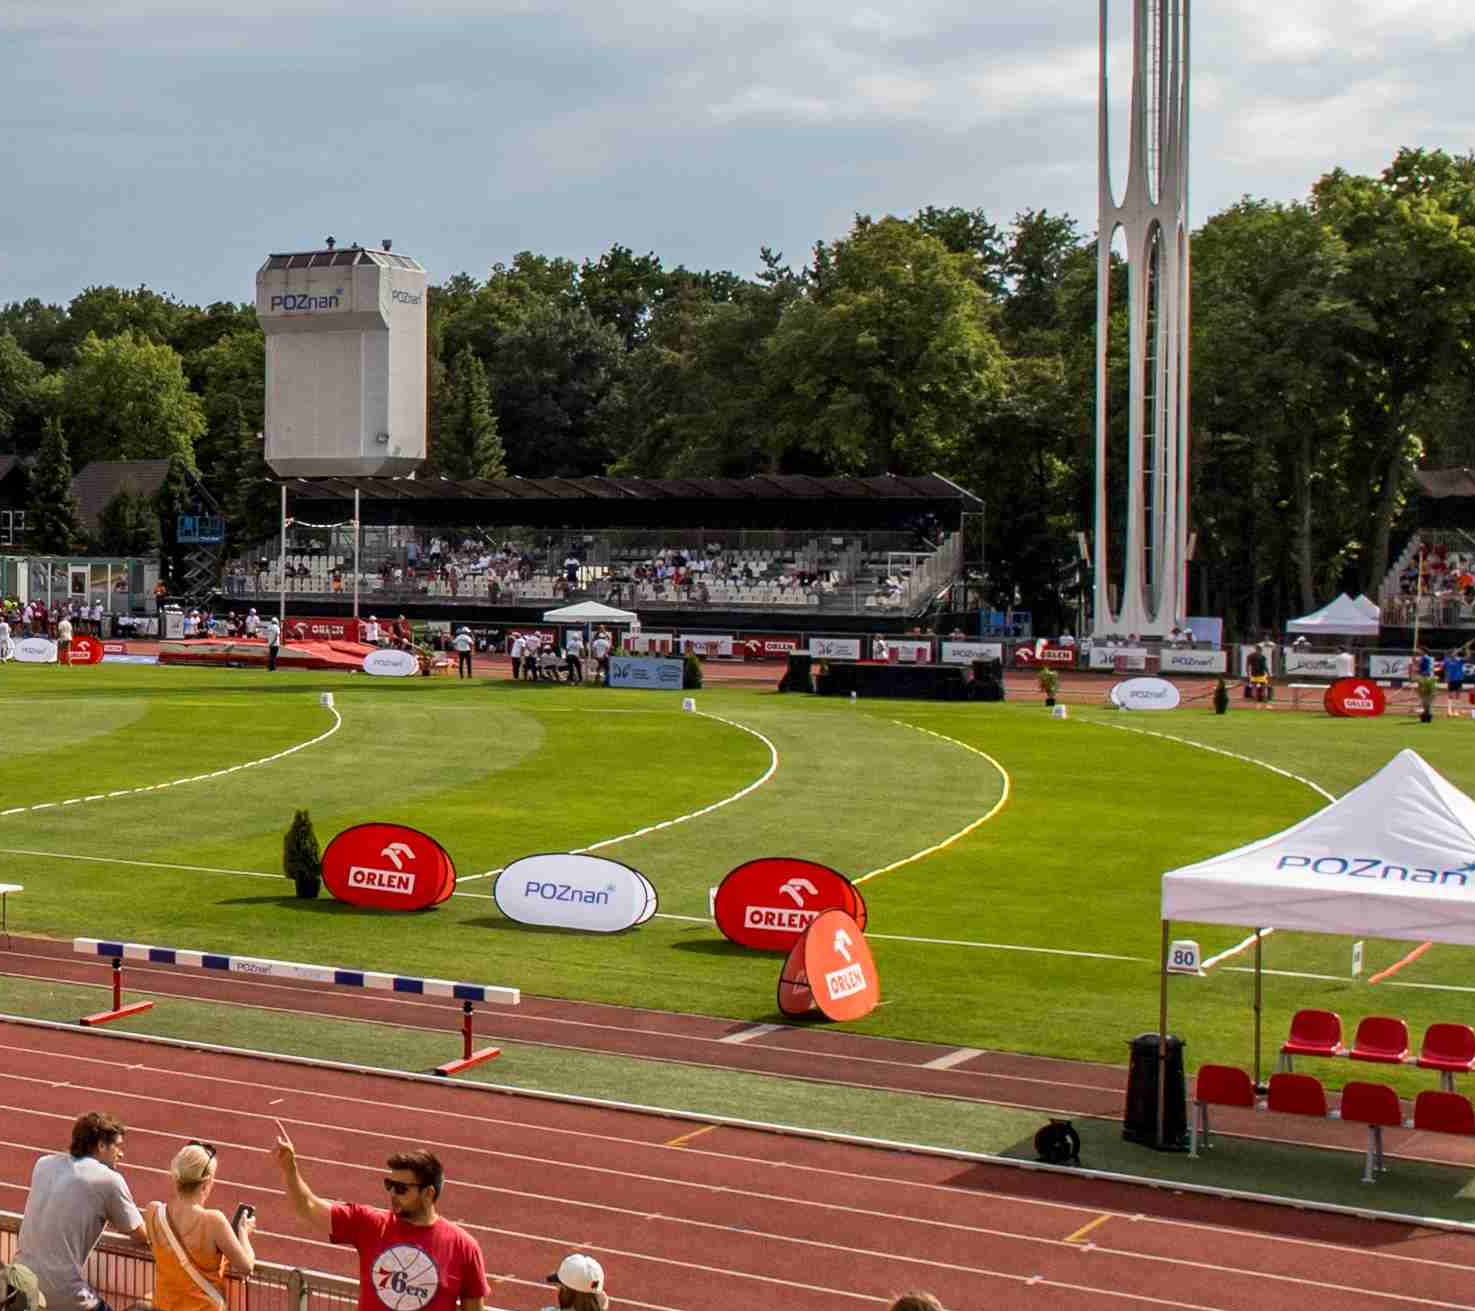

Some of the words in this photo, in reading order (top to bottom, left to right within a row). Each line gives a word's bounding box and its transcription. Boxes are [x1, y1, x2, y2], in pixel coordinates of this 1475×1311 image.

[271, 294, 339, 312] POZnan
[352, 871, 411, 891] ORLEN
[1277, 854, 1468, 887] POZnan
[525, 881, 609, 905] POZnan
[750, 910, 814, 929] ORLEN
[1174, 951, 1195, 967] 80
[830, 970, 864, 995] ORLEN
[375, 1266, 429, 1299] 76ers
